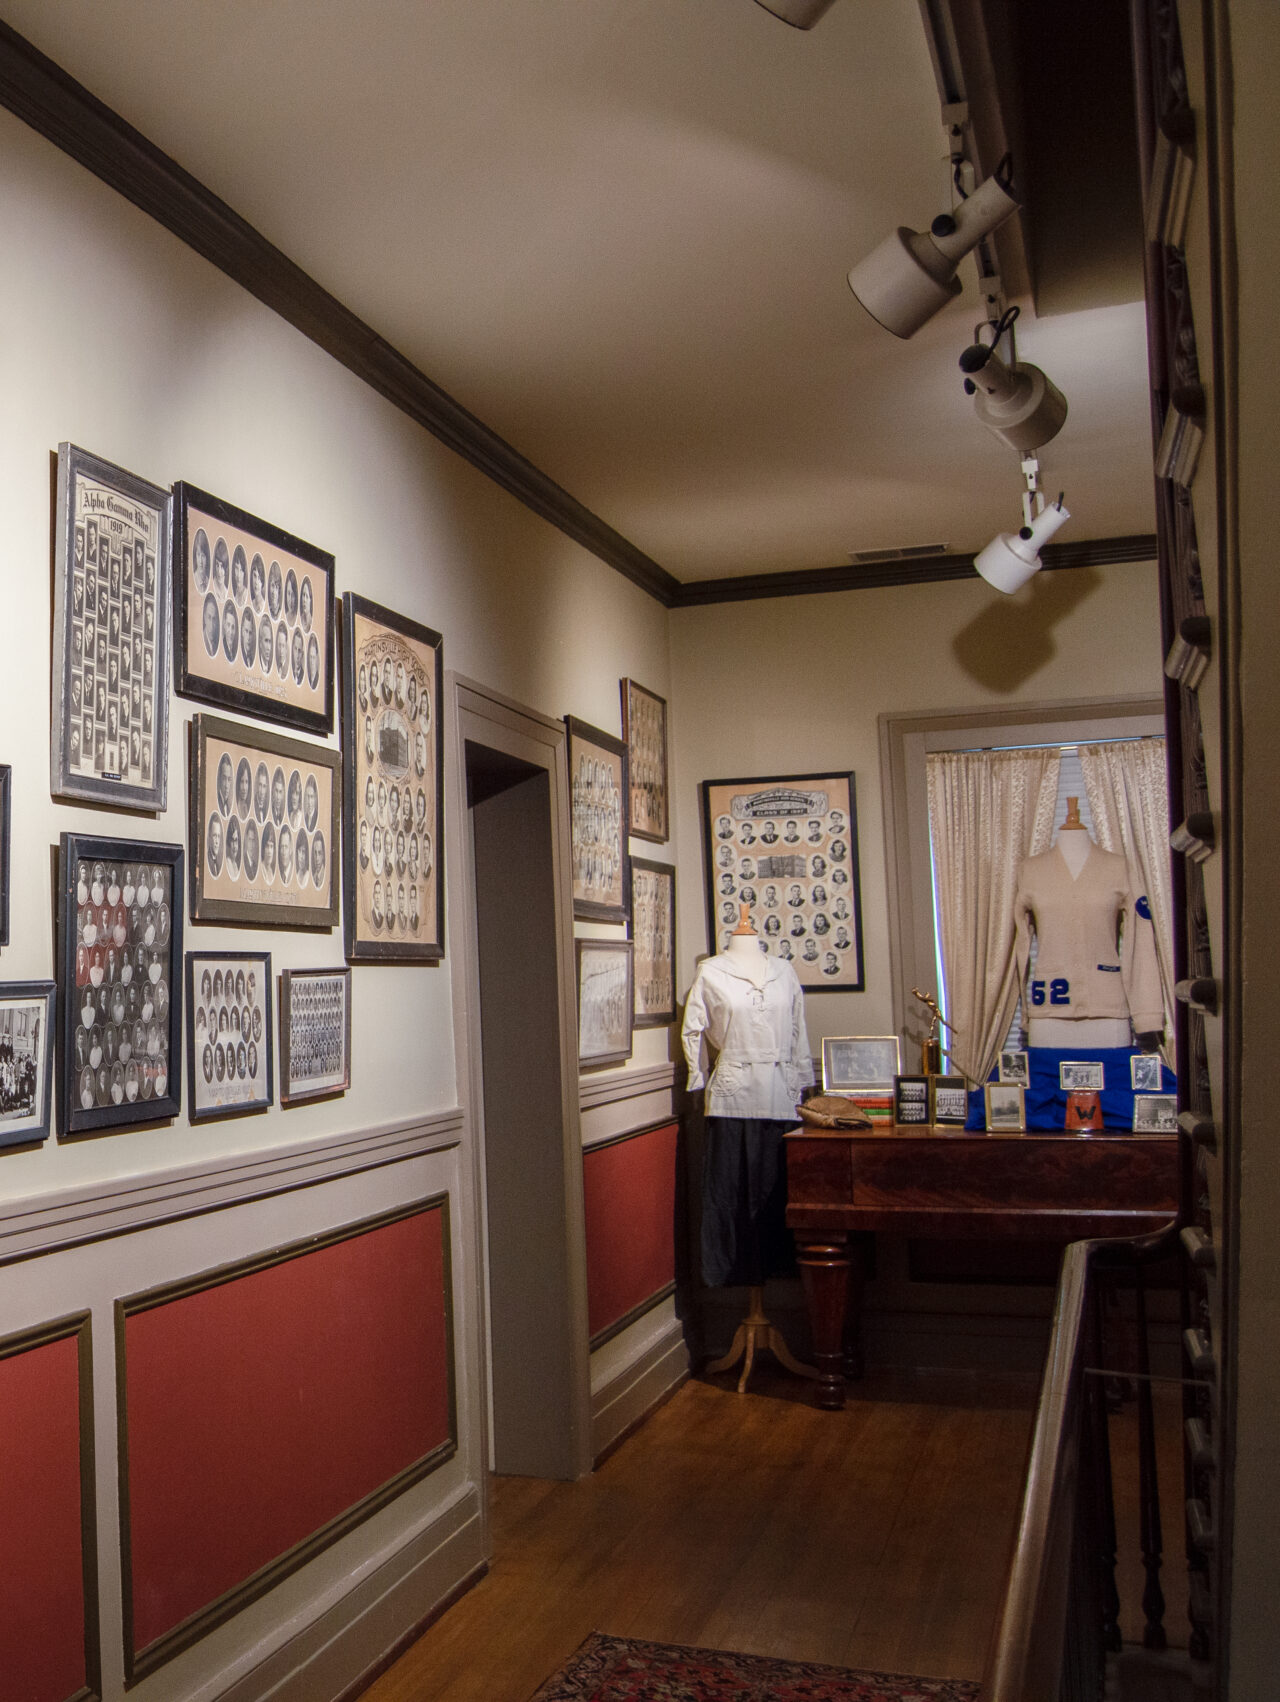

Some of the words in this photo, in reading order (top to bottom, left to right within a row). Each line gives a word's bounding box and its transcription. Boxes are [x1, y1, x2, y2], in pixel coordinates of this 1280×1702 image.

[83, 492, 105, 512] Alpha
[107, 496, 133, 522] Gamma
[134, 508, 149, 533] Rho
[110, 520, 123, 534] 1919
[1075, 1106, 1096, 1120] W
